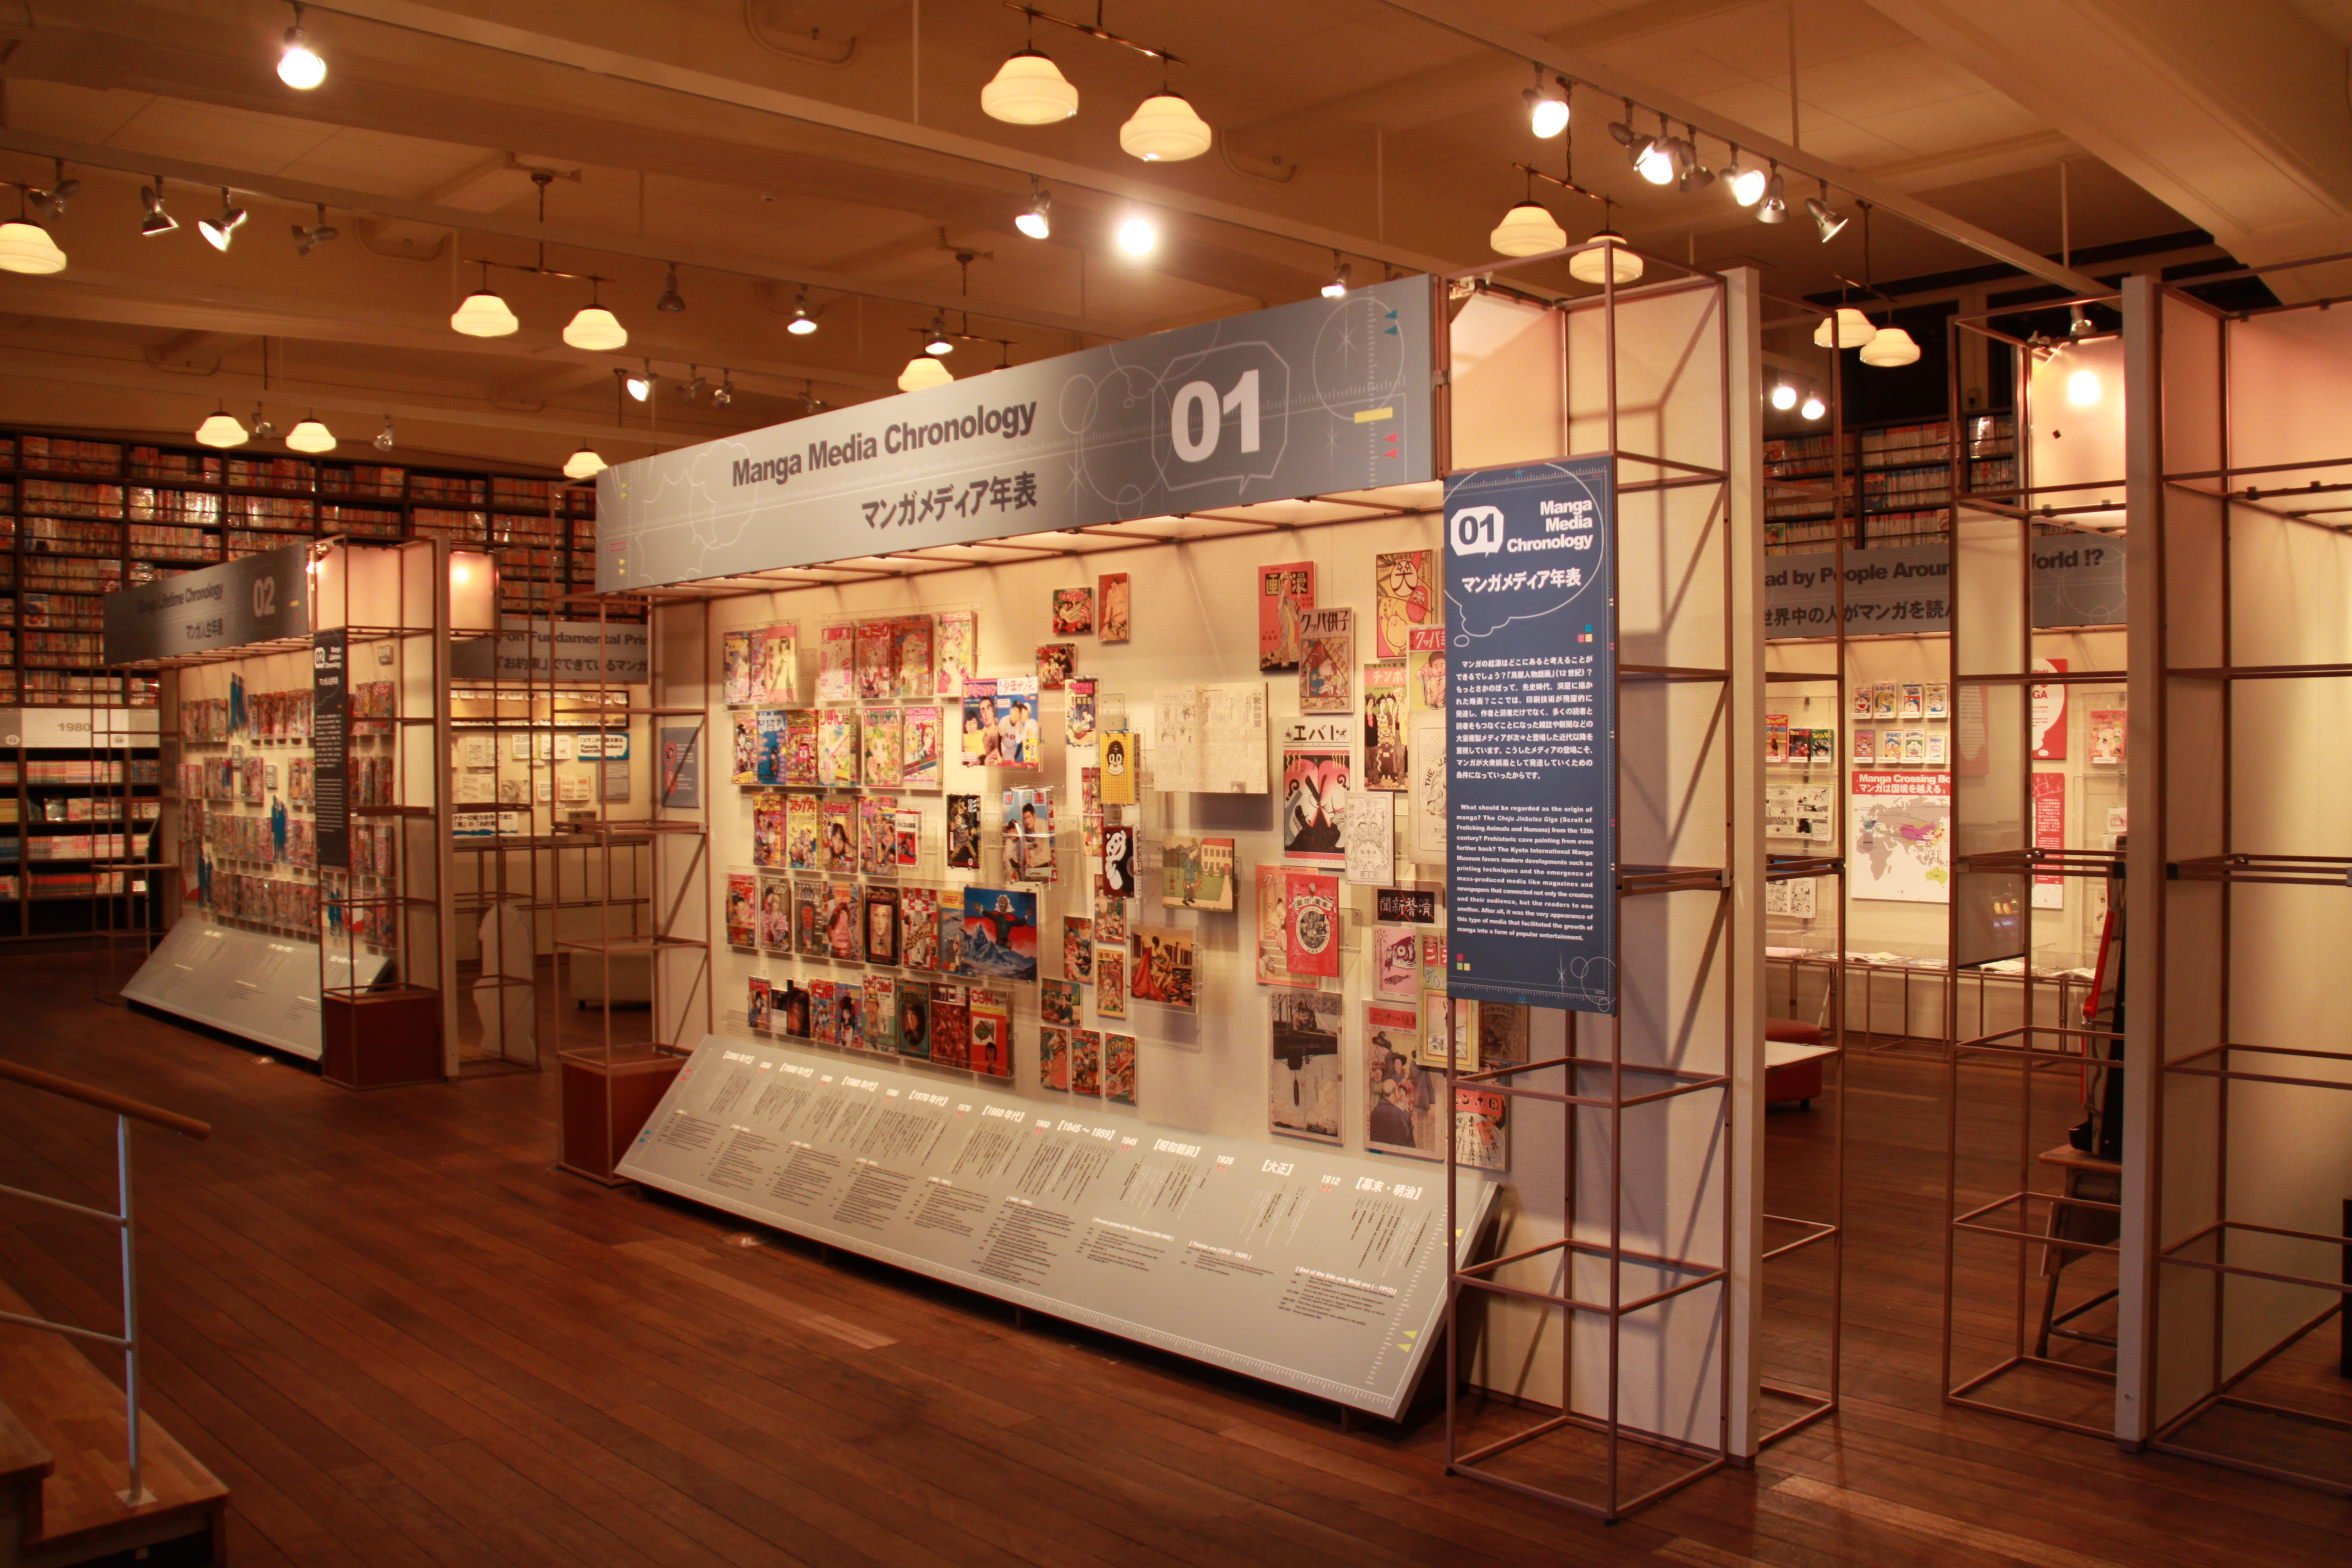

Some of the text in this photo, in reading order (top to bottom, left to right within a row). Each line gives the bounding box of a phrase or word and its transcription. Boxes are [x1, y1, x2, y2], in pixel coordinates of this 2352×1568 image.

[1170, 367, 1261, 464] 01
[732, 400, 1037, 489] Manga Media Chronology
[861, 471, 1037, 530] マンガメディア年表
[1540, 498, 1593, 516] Manga
[1546, 515, 1592, 532] Media
[1458, 513, 1495, 546] 01
[1507, 533, 1594, 553] Chronology
[1462, 568, 1582, 594] マンガメディア年表
[1793, 569, 1816, 588] by
[252, 576, 275, 617] 02
[58, 722, 92, 732] 1980
[1859, 774, 1892, 784] Manga
[1893, 774, 1936, 785] Crossing
[1564, 806, 1584, 814] origin
[1456, 814, 1482, 822] manga?
[1456, 824, 1486, 832] Frolicking
[1510, 846, 1529, 854] Kyoto
[1572, 849, 1594, 857] Manga
[1524, 858, 1568, 866] developments
[1482, 866, 1518, 874] techniques
[1456, 876, 1505, 884] mass-produced
[1544, 890, 1557, 898] only
[1550, 912, 1586, 920] appearance
[1521, 920, 1552, 928] facilitated
[1121, 1136, 1138, 1146] 1945
[1322, 1174, 1342, 1186] 1912
